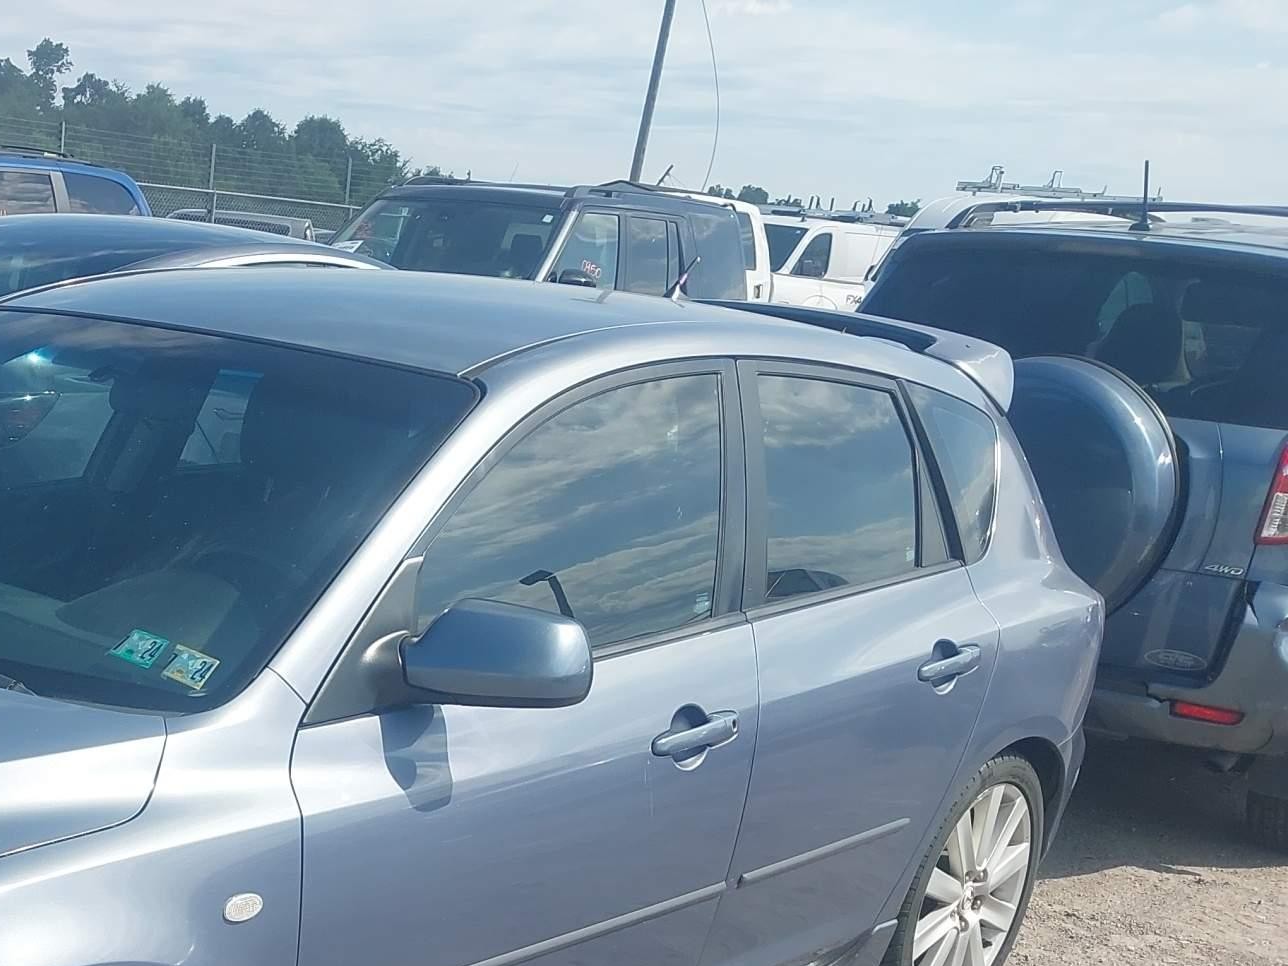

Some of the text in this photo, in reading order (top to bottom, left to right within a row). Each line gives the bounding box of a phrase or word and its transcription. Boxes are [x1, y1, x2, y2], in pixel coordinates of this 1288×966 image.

[1204, 564, 1244, 575] 4WD
[140, 640, 164, 663] 24
[190, 660, 214, 683] 24
